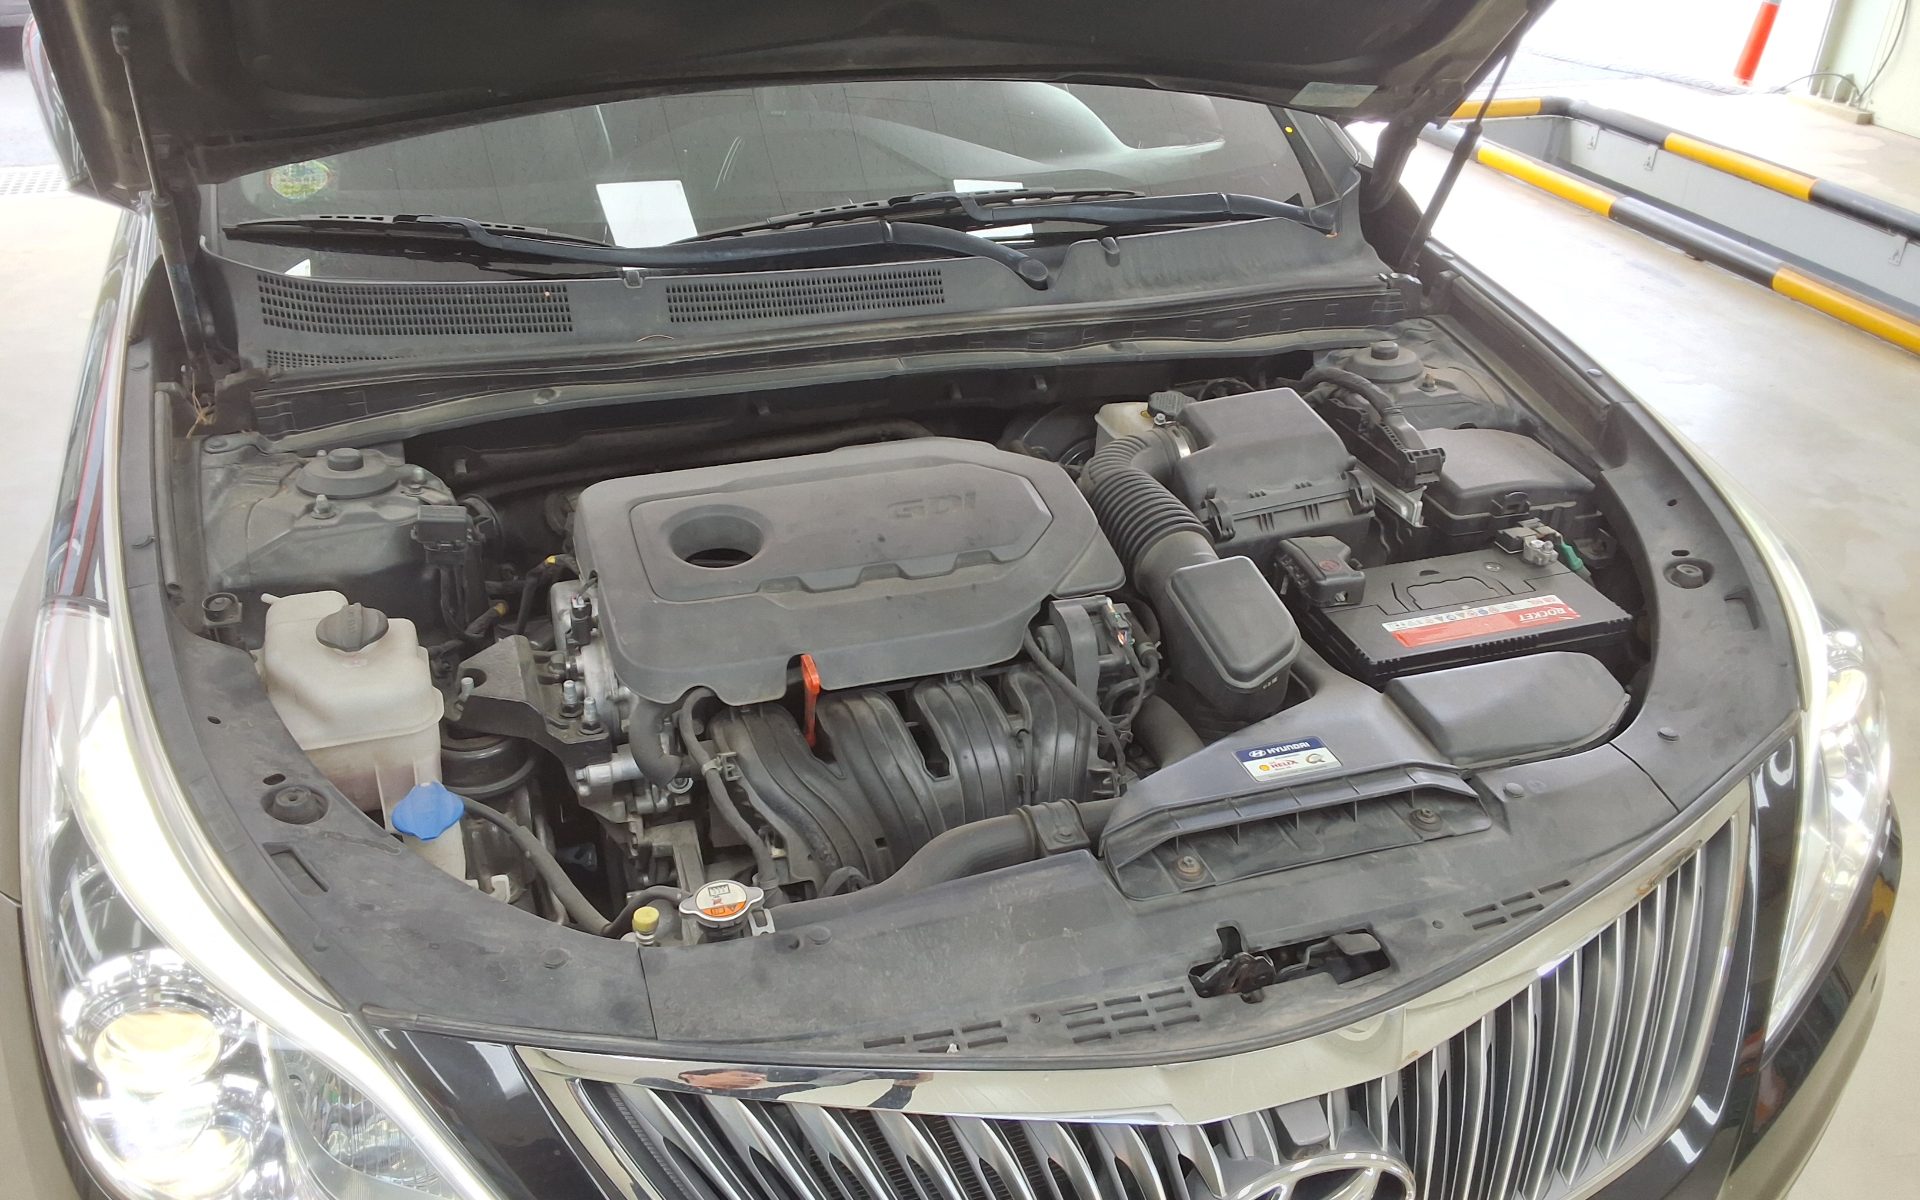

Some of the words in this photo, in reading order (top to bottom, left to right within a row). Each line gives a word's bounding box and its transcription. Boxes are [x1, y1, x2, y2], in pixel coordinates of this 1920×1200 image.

[886, 490, 977, 519] GDI
[1518, 607, 1567, 622] ROCKET
[1266, 741, 1311, 755] HYUNDAI
